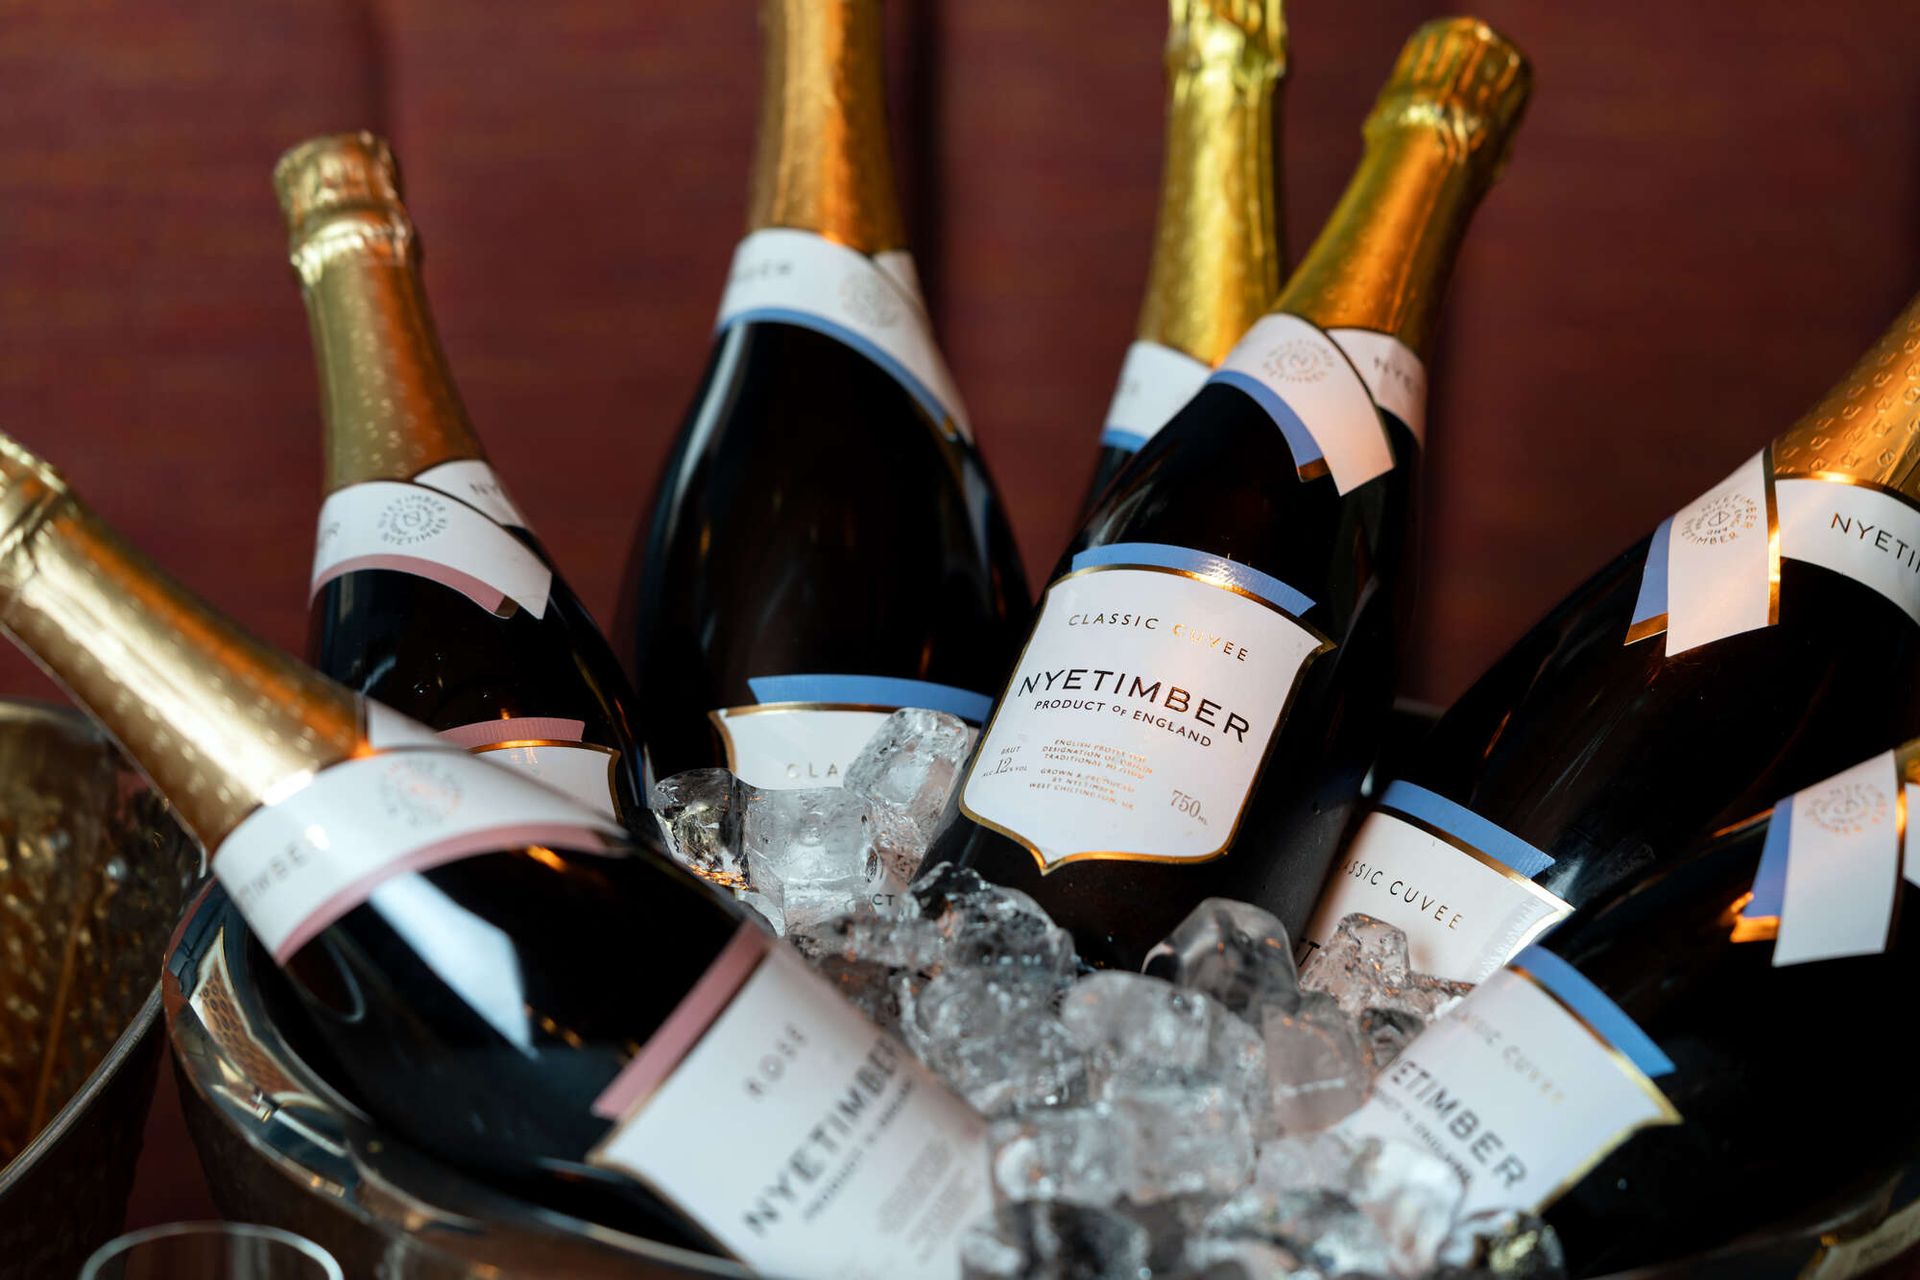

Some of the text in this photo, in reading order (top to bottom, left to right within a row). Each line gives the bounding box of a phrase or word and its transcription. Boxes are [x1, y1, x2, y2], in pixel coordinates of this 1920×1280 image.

[1831, 512, 1920, 574] NYETI
[1068, 613, 1249, 662] CLASSIC CUVEE
[1018, 669, 1250, 743] NYETIMBER
[1034, 699, 1106, 712] PRODUCT
[1132, 710, 1212, 748] ENGLAND
[1344, 860, 1463, 931] SSIC CUVEE
[1391, 1059, 1528, 1191] ETIMBER
